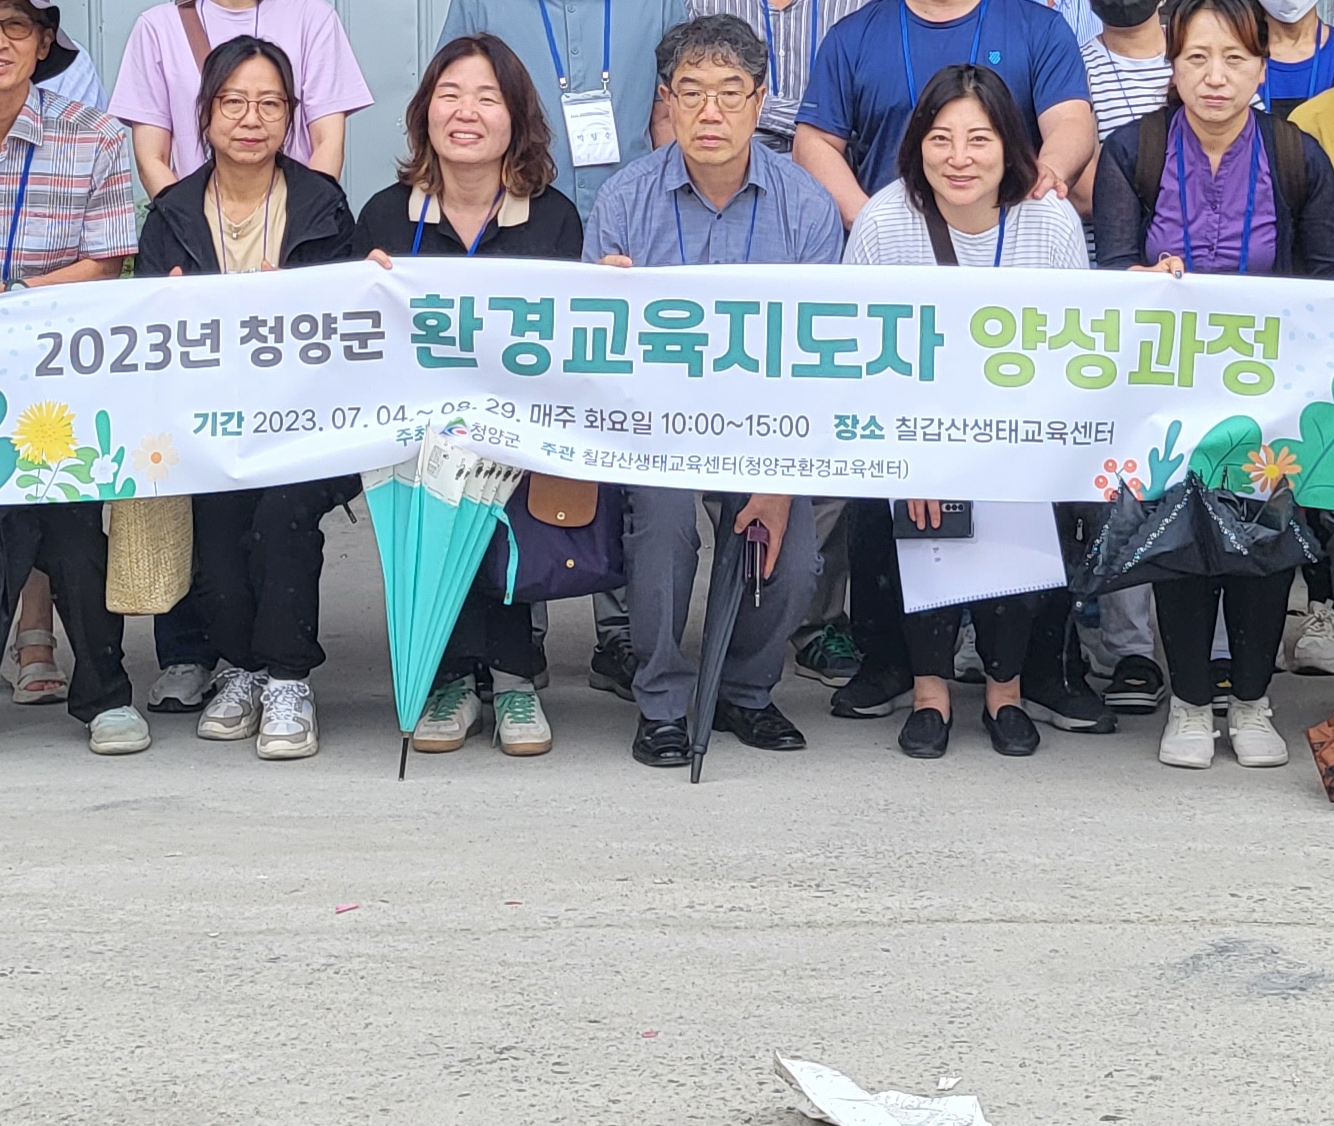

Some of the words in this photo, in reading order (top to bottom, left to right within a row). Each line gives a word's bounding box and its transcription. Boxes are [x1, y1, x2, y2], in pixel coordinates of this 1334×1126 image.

[34, 317, 221, 377] 2023년
[239, 310, 386, 368] 청양군
[409, 292, 945, 382] 환경교육지도자
[970, 305, 1282, 397] 양성과정
[192, 410, 245, 437] 기간
[252, 409, 324, 435] 2023.
[331, 406, 368, 430] 07.
[529, 403, 577, 430] 매주
[583, 407, 653, 436] 화요일
[661, 411, 810, 438] 10:00~15:00
[833, 412, 887, 442] 장소
[894, 414, 1116, 446] 칠갑산생태교육센터
[470, 421, 522, 449] 청양군
[541, 441, 576, 462] 주관
